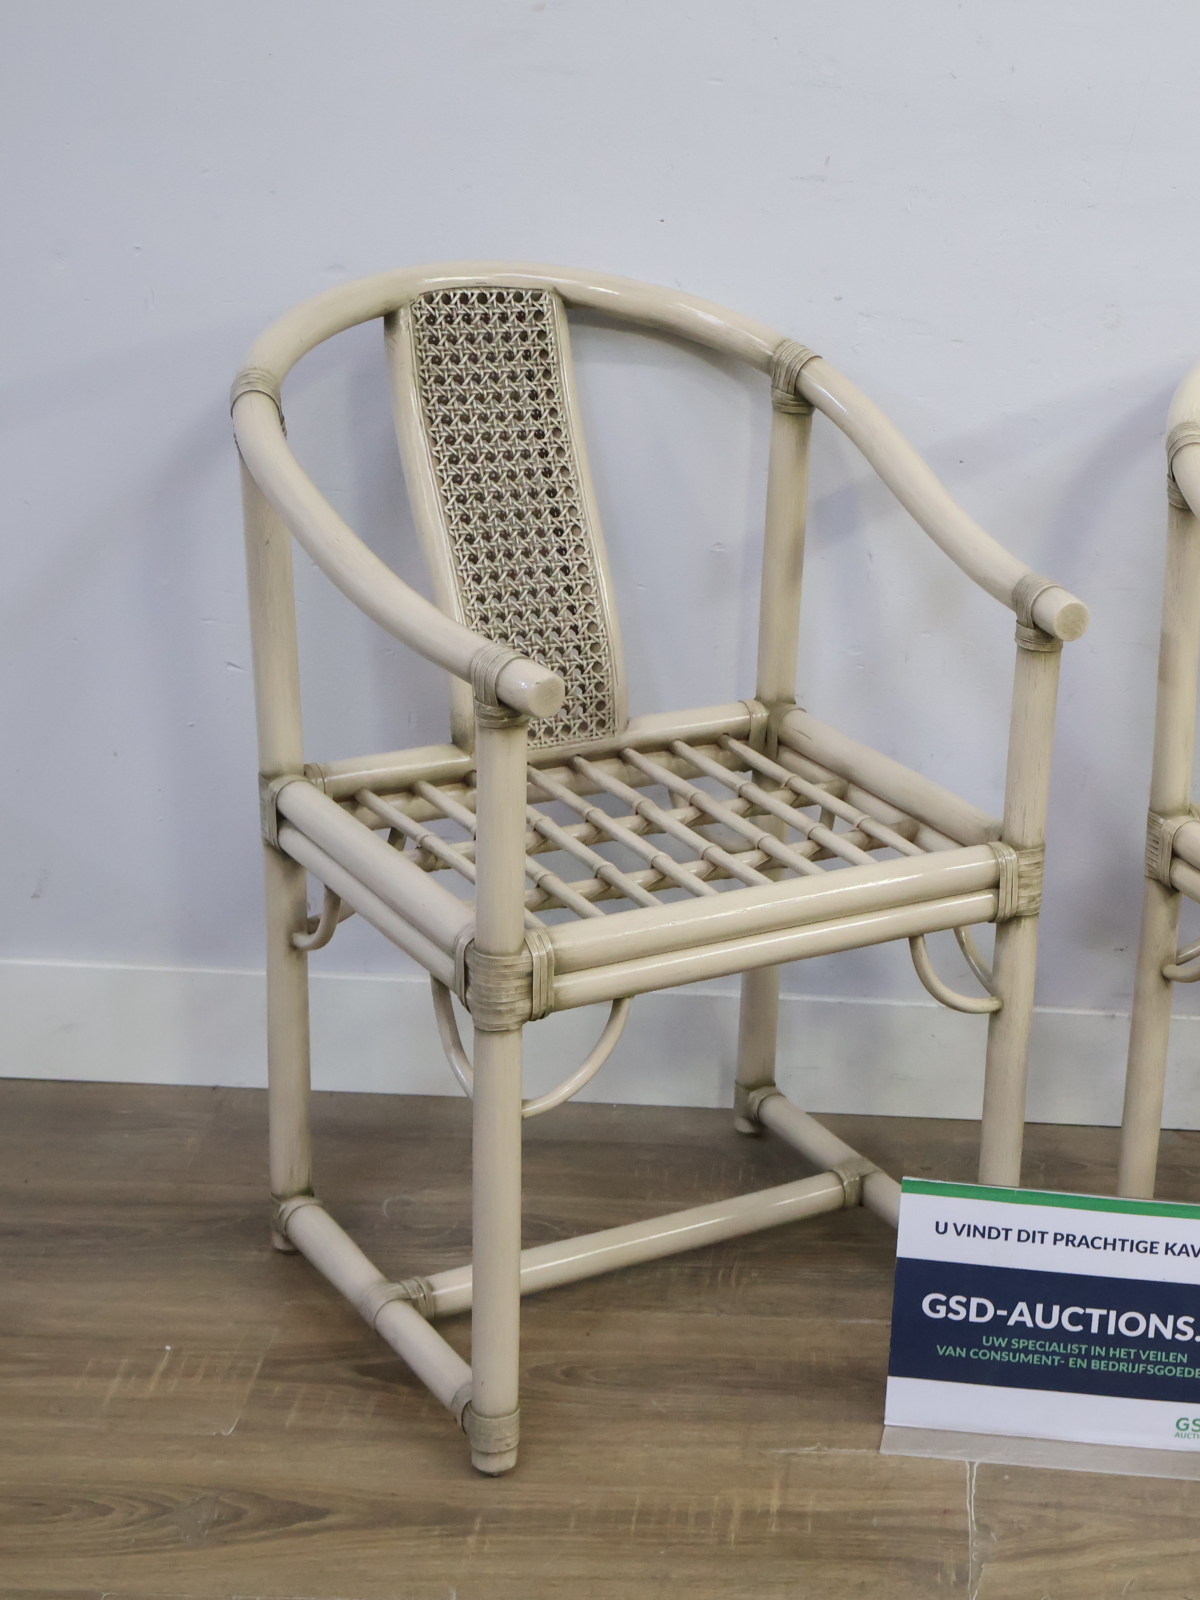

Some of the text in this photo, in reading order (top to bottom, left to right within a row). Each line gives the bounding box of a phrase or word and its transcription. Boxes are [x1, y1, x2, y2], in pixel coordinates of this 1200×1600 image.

[935, 1221, 948, 1235] U
[953, 1223, 1013, 1242] VINDT
[1017, 1229, 1048, 1244] DIT
[1053, 1233, 1159, 1255] PRACHTIGE
[937, 1345, 966, 1358] VAN
[970, 1348, 1065, 1367] CONSUMENT-
[1069, 1357, 1087, 1369] EN
[983, 1335, 1188, 1363] UW SPECIALIST IN HET VEILEN
